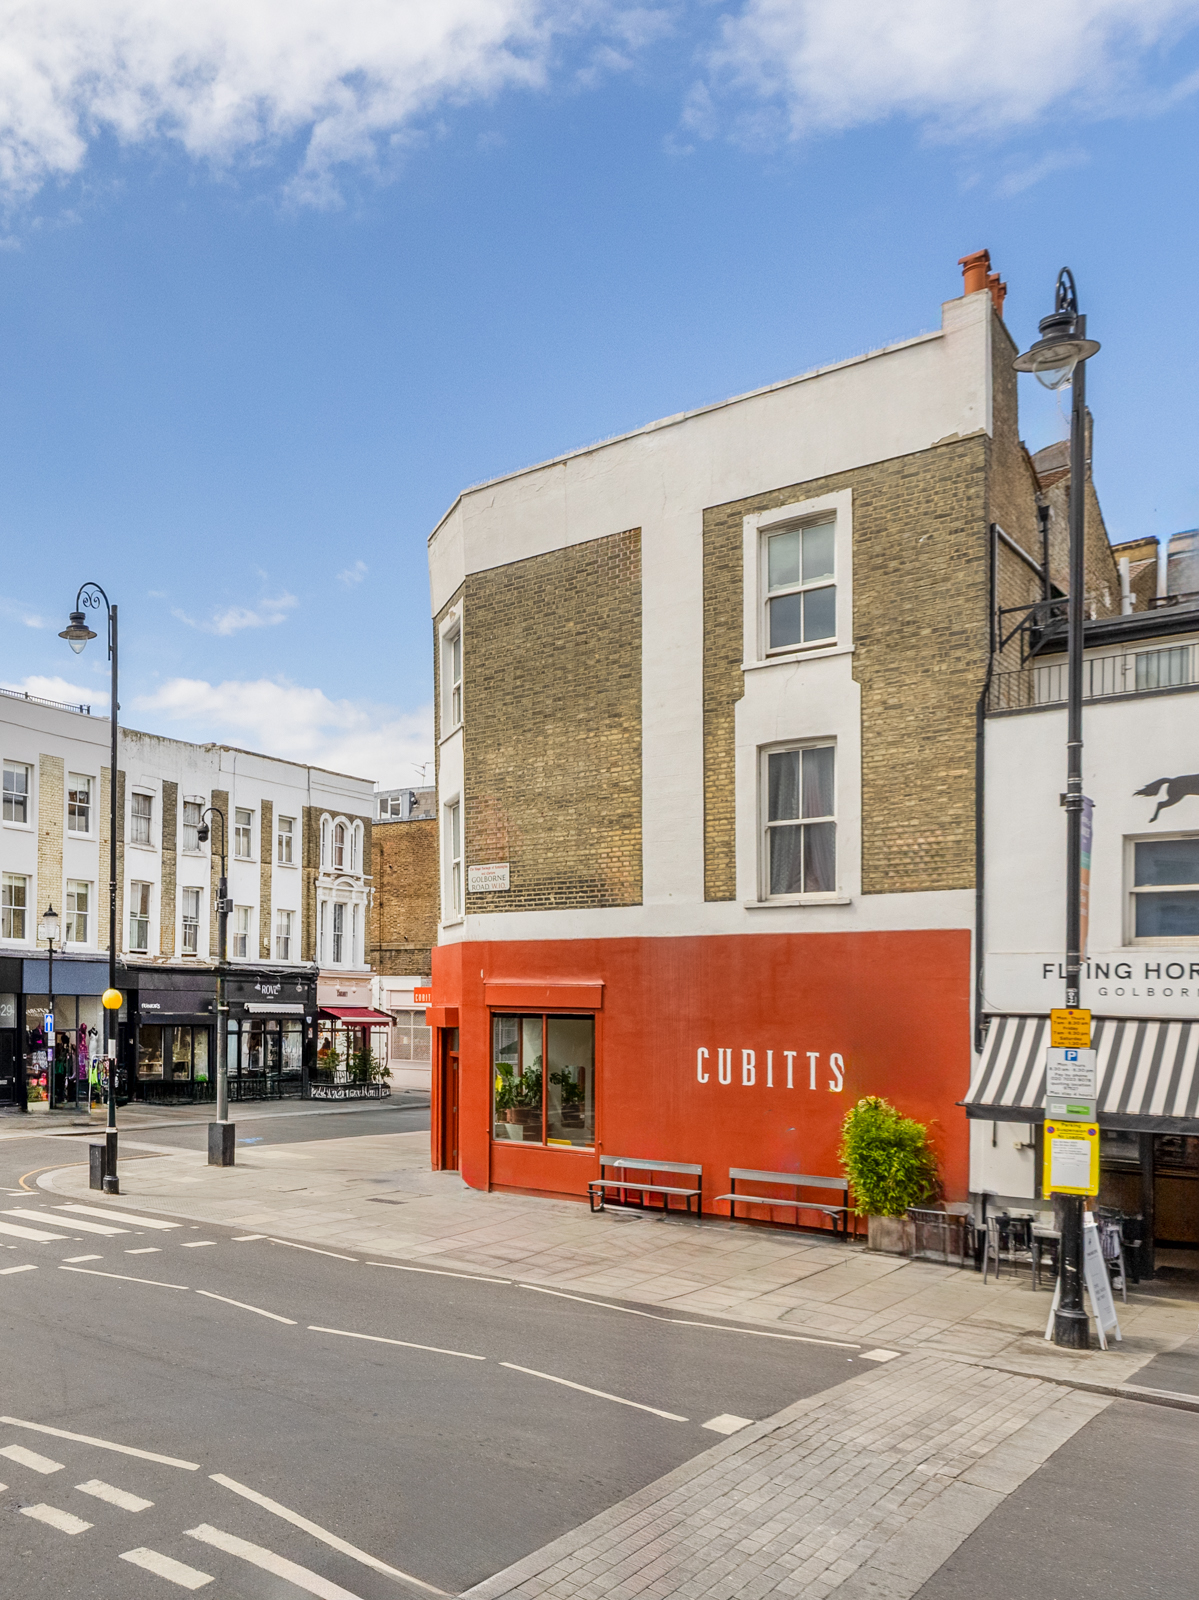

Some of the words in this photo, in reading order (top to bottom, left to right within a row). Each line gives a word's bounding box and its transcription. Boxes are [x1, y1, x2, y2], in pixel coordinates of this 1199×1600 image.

[471, 874, 506, 883] GOLBORNE
[1043, 962, 1133, 979] FLING
[1098, 987, 1199, 997] GOLBOR
[1067, 1051, 1076, 1060] P
[697, 1047, 845, 1092] CUBITTS
